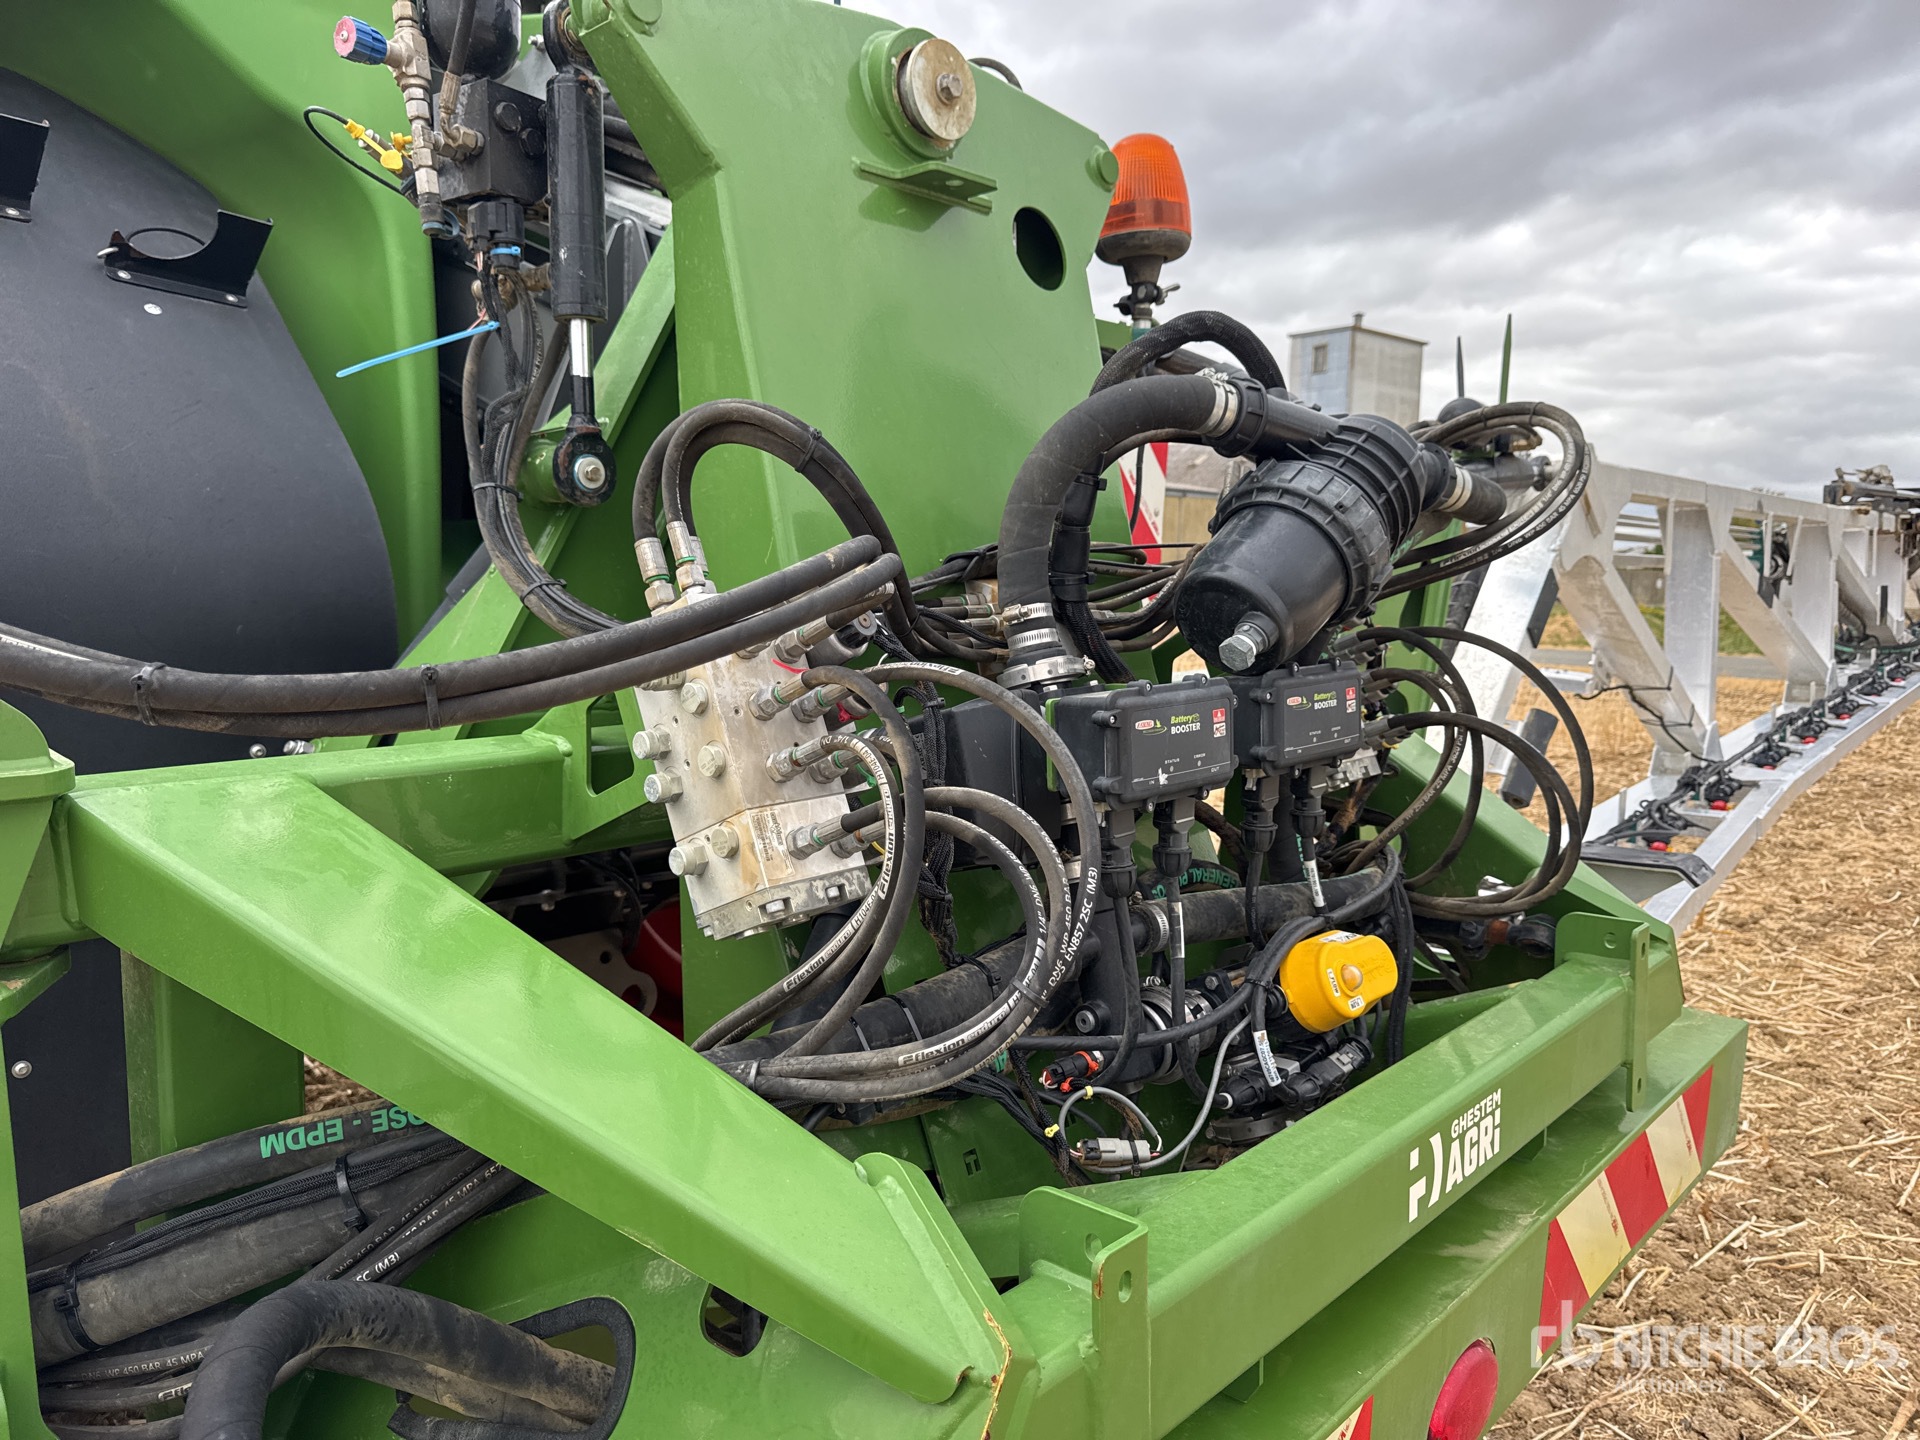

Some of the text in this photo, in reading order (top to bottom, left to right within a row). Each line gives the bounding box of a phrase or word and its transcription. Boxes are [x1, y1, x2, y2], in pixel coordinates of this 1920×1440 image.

[1314, 699, 1337, 710] BOOSTER
[1170, 714, 1194, 724] Battery
[1170, 722, 1201, 734] BOOSTER
[821, 735, 833, 745] DN
[862, 749, 884, 781] H104E-04
[1189, 868, 1238, 889] GENERAL
[1029, 884, 1044, 908] DN6
[1062, 879, 1072, 905] BAR
[1065, 907, 1073, 930] 450
[1066, 867, 1099, 962] EN857 2SC (M3)
[1060, 932, 1071, 954] WP
[1451, 1088, 1501, 1138] GHESTEM
[259, 1118, 345, 1159] EPDM
[456, 1178, 480, 1199] MPA
[374, 1251, 401, 1274] (M3)
[122, 1365, 140, 1376] 450
[141, 1361, 161, 1373] BAR
[165, 1357, 179, 1367] 45
[180, 1351, 205, 1365] MPA
